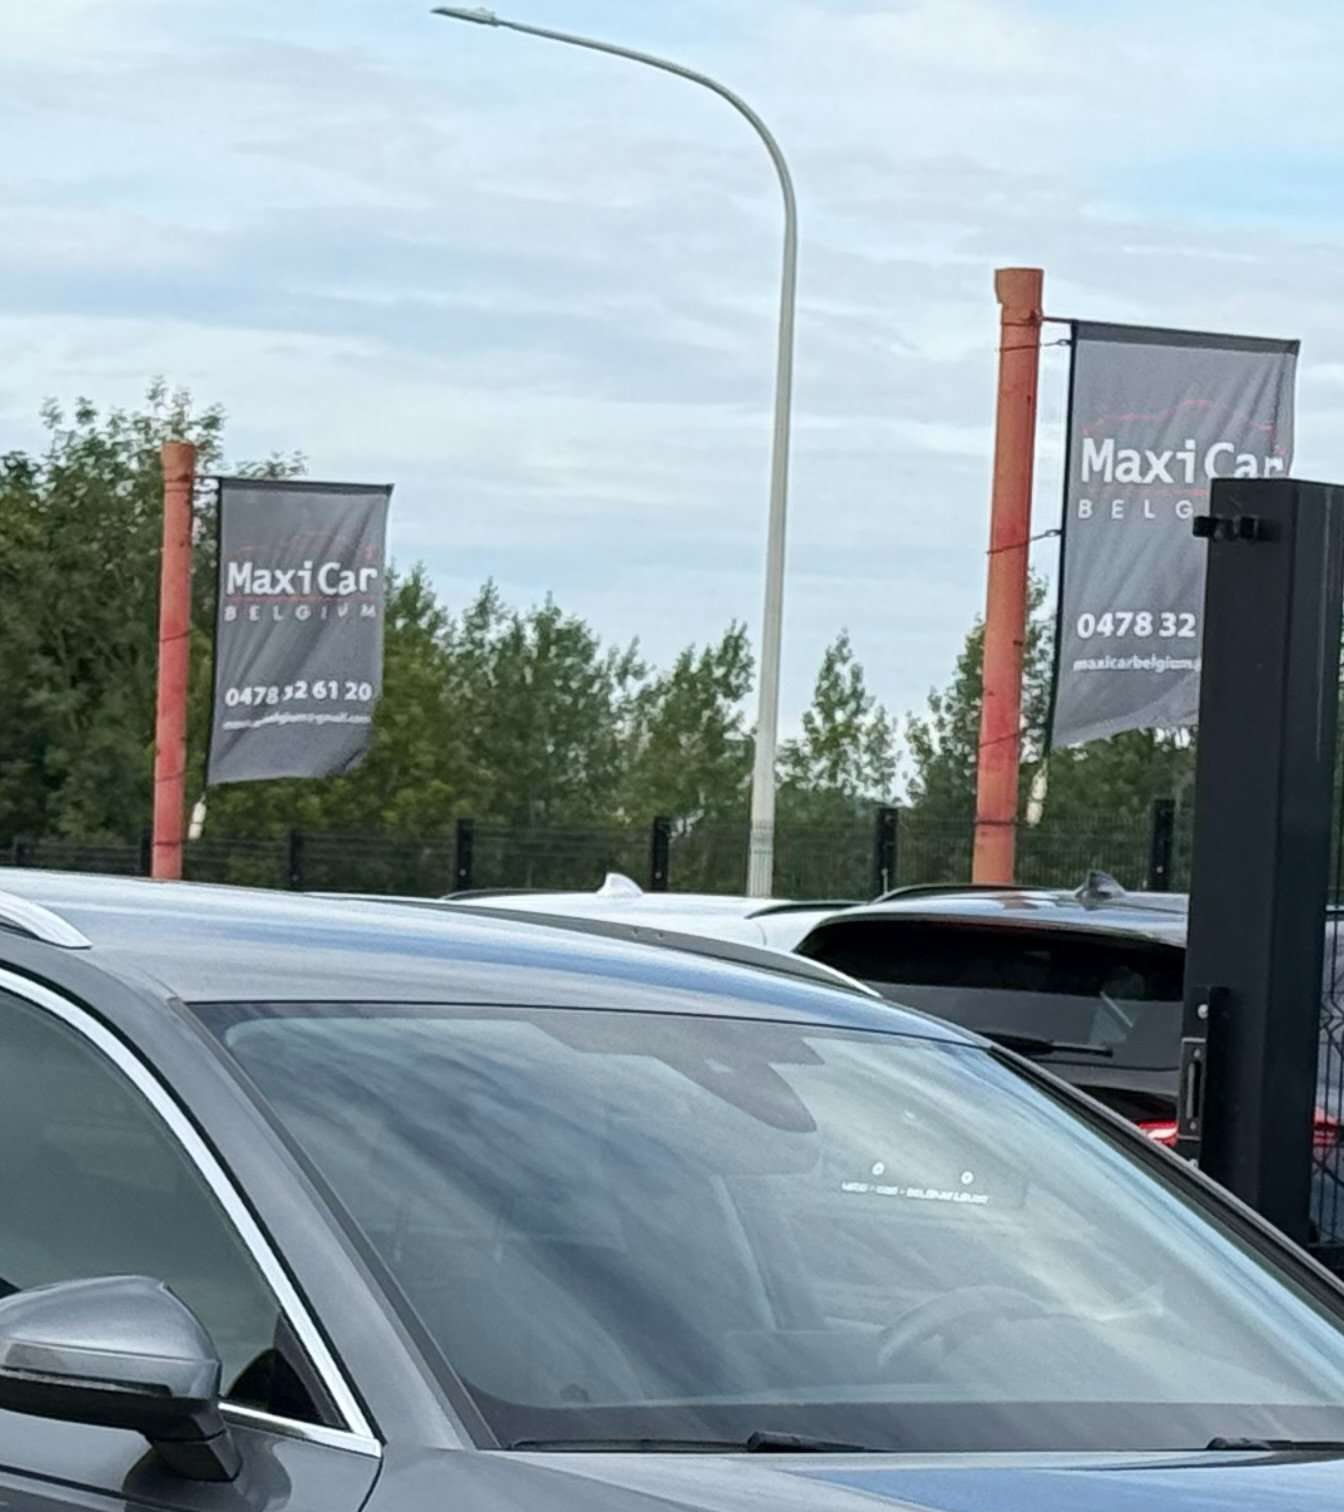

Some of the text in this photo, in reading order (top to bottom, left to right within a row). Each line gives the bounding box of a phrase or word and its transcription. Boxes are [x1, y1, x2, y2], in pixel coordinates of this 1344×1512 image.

[226, 560, 378, 596] MaxiCar
[223, 604, 377, 622] BELGIUM
[1077, 611, 1197, 638] 0478 32
[225, 687, 279, 706] 0478
[312, 680, 338, 700] 61
[344, 682, 372, 701] 20
